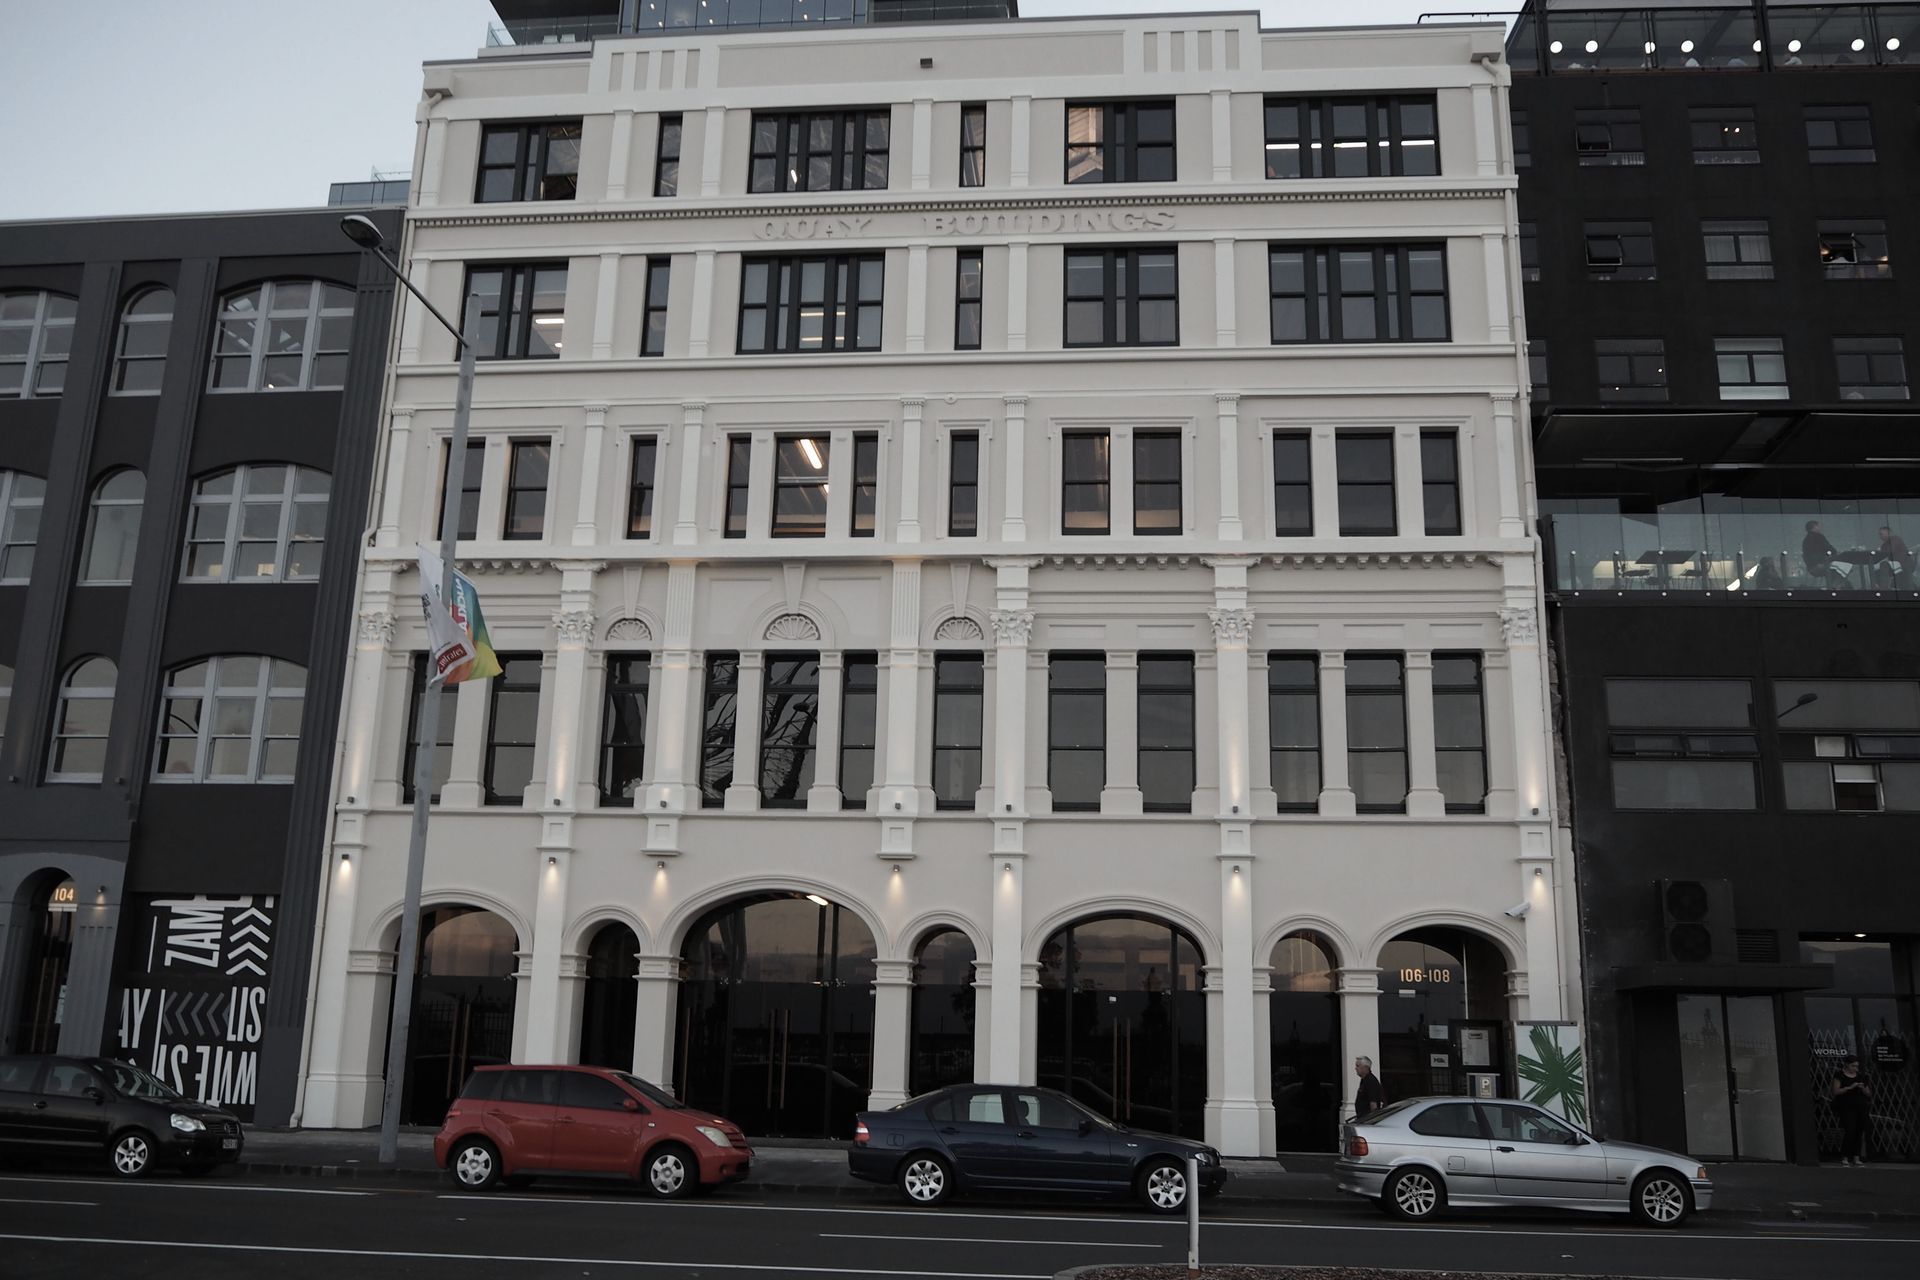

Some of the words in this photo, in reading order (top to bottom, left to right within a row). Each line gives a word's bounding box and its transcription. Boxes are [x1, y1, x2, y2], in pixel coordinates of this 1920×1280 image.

[753, 217, 873, 240] QUAY
[922, 210, 1176, 235] BUILDINGS
[54, 888, 74, 901] 104
[1400, 968, 1450, 983] 106-108
[1814, 1048, 1848, 1056] WORLD
[1481, 1079, 1490, 1089] P
